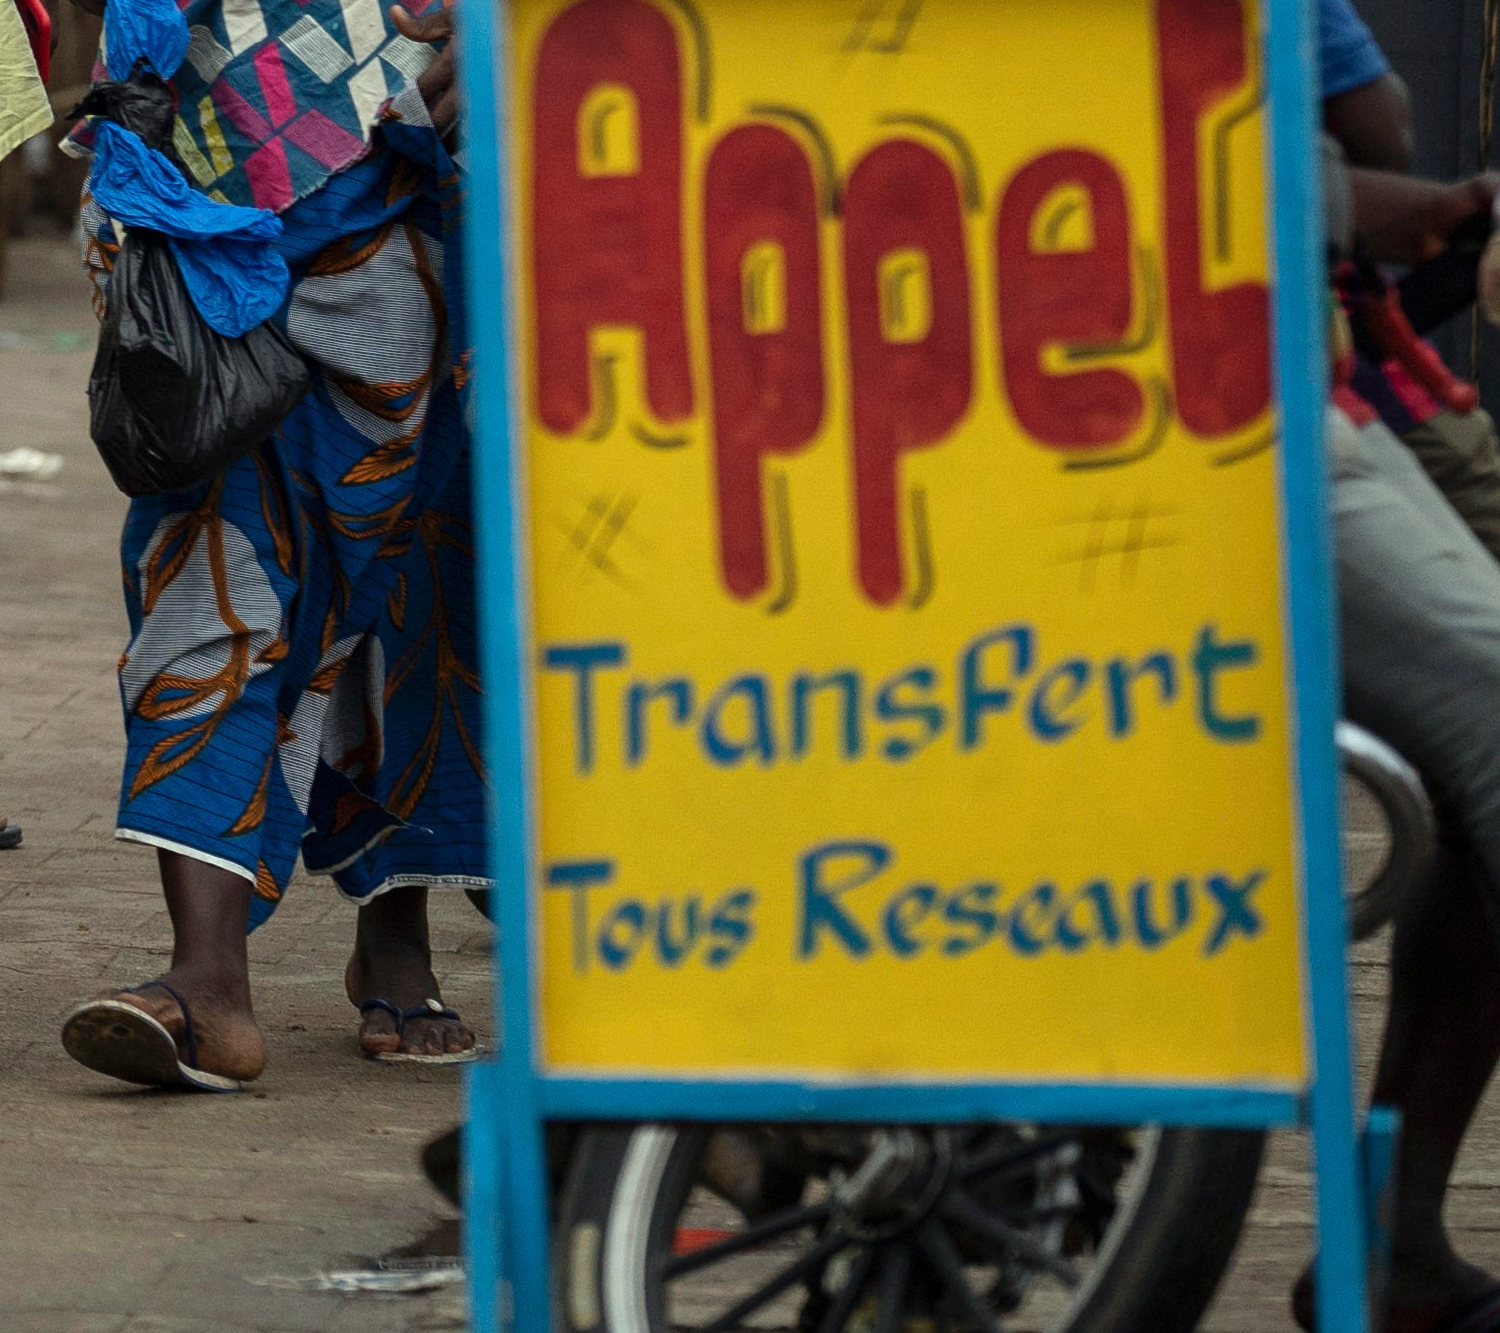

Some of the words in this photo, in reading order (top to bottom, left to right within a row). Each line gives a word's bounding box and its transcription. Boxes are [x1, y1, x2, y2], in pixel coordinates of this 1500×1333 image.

[544, 623, 1262, 774] Transfert
[546, 859, 758, 973] Tous
[794, 837, 1271, 961] Reseaux
